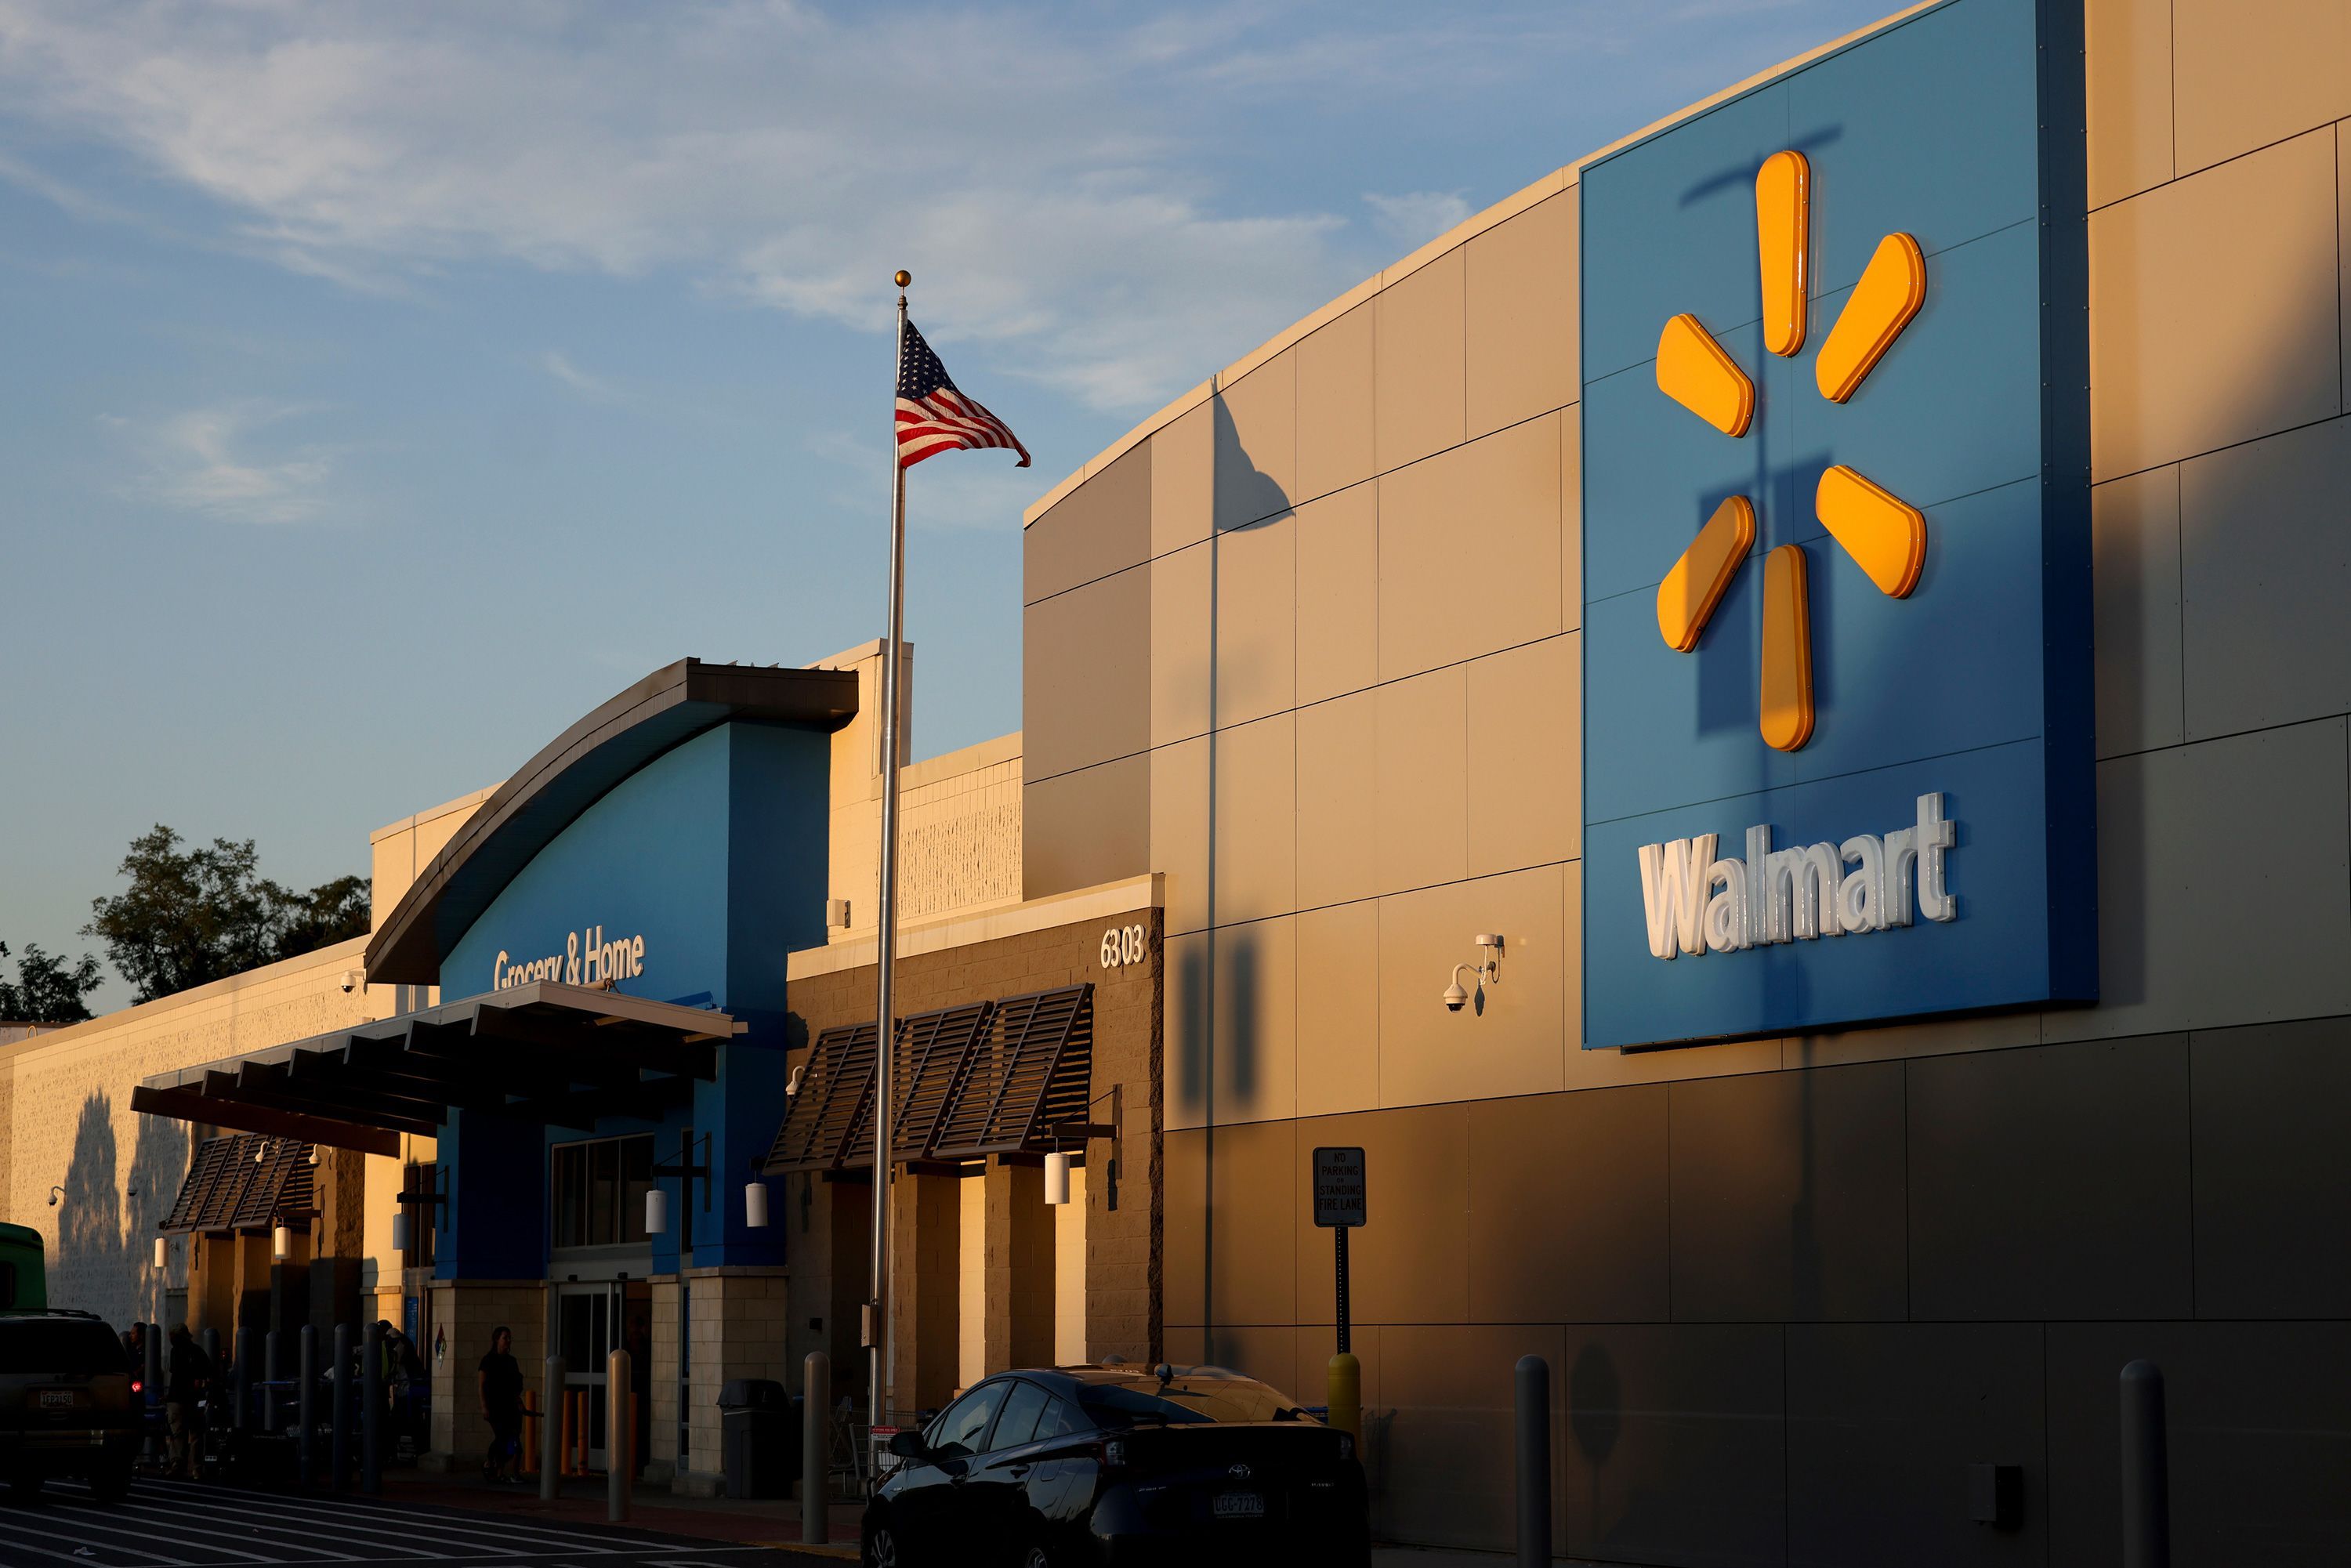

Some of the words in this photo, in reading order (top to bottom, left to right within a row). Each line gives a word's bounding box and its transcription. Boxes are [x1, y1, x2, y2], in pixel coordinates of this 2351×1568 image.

[1639, 791, 1956, 961] Walmart
[1100, 924, 1145, 969] 6303
[494, 950, 564, 990] Grocery
[566, 931, 581, 987] &
[585, 925, 645, 984] Home
[1334, 1153, 1346, 1163] NO
[1322, 1165, 1359, 1176] PARKING
[1320, 1185, 1361, 1196] STANDING
[1319, 1198, 1338, 1211] FIRE
[1340, 1198, 1362, 1211] LANE
